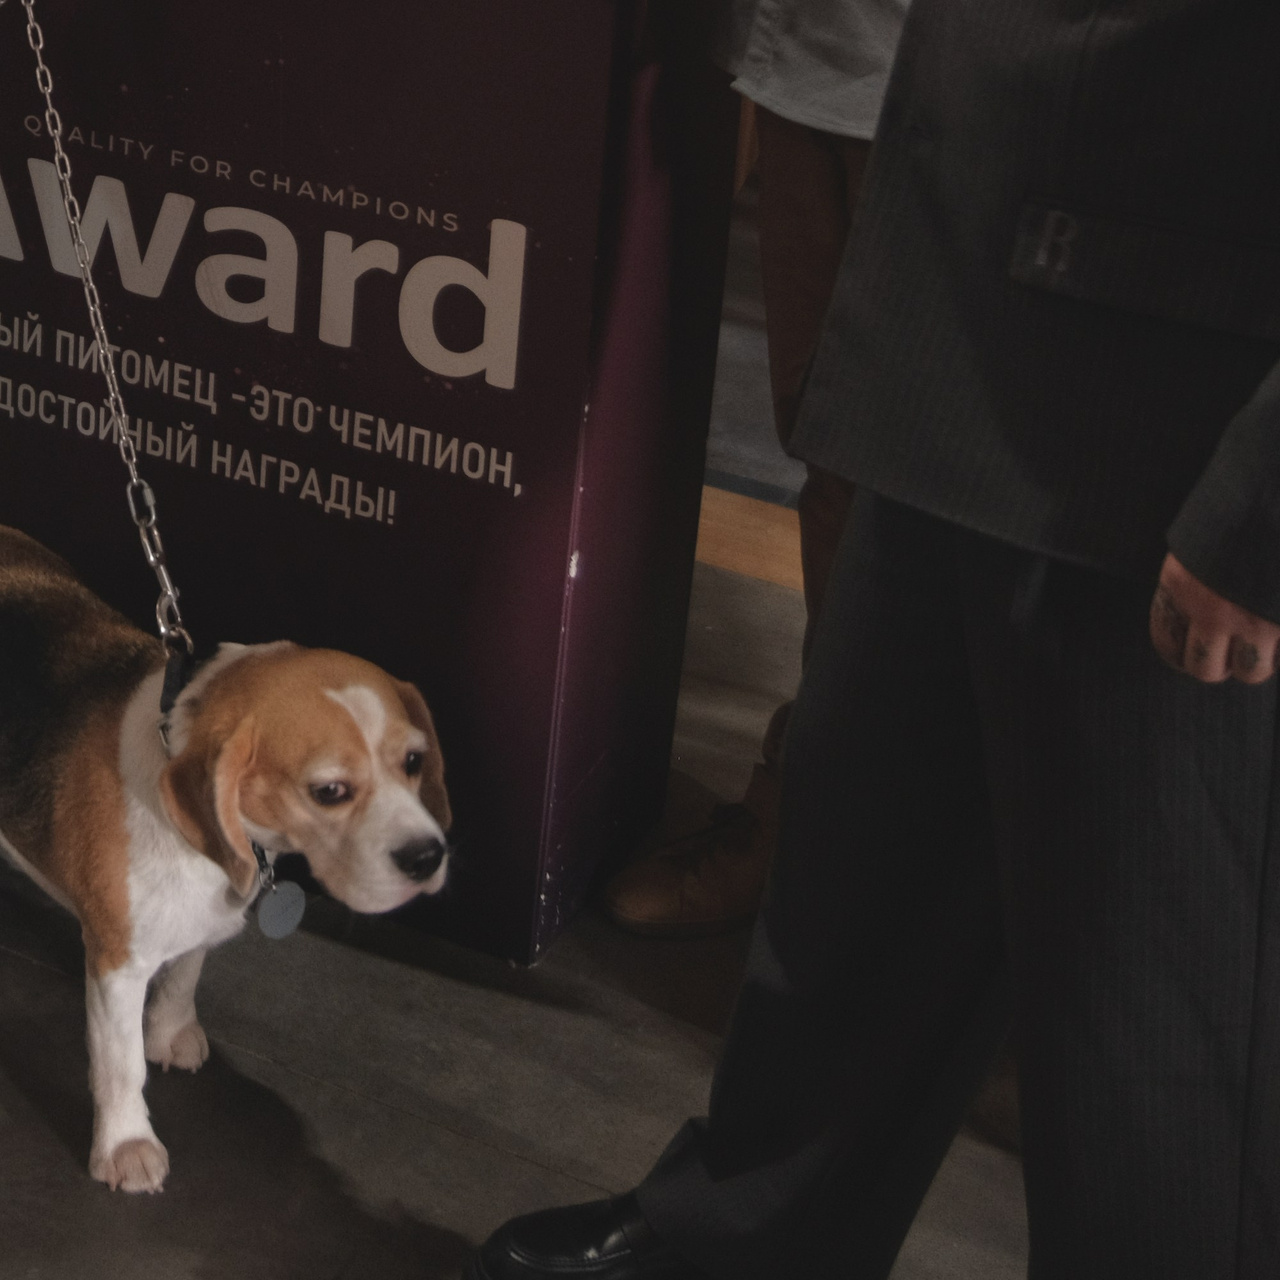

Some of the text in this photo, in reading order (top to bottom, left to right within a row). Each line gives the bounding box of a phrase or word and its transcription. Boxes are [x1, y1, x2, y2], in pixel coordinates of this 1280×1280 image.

[23, 114, 459, 232] QALITY FOR CHAMPIONS
[211, 439, 396, 525] НАГРАДЫ!
[328, 406, 523, 497] ЧЕМПИОН,
